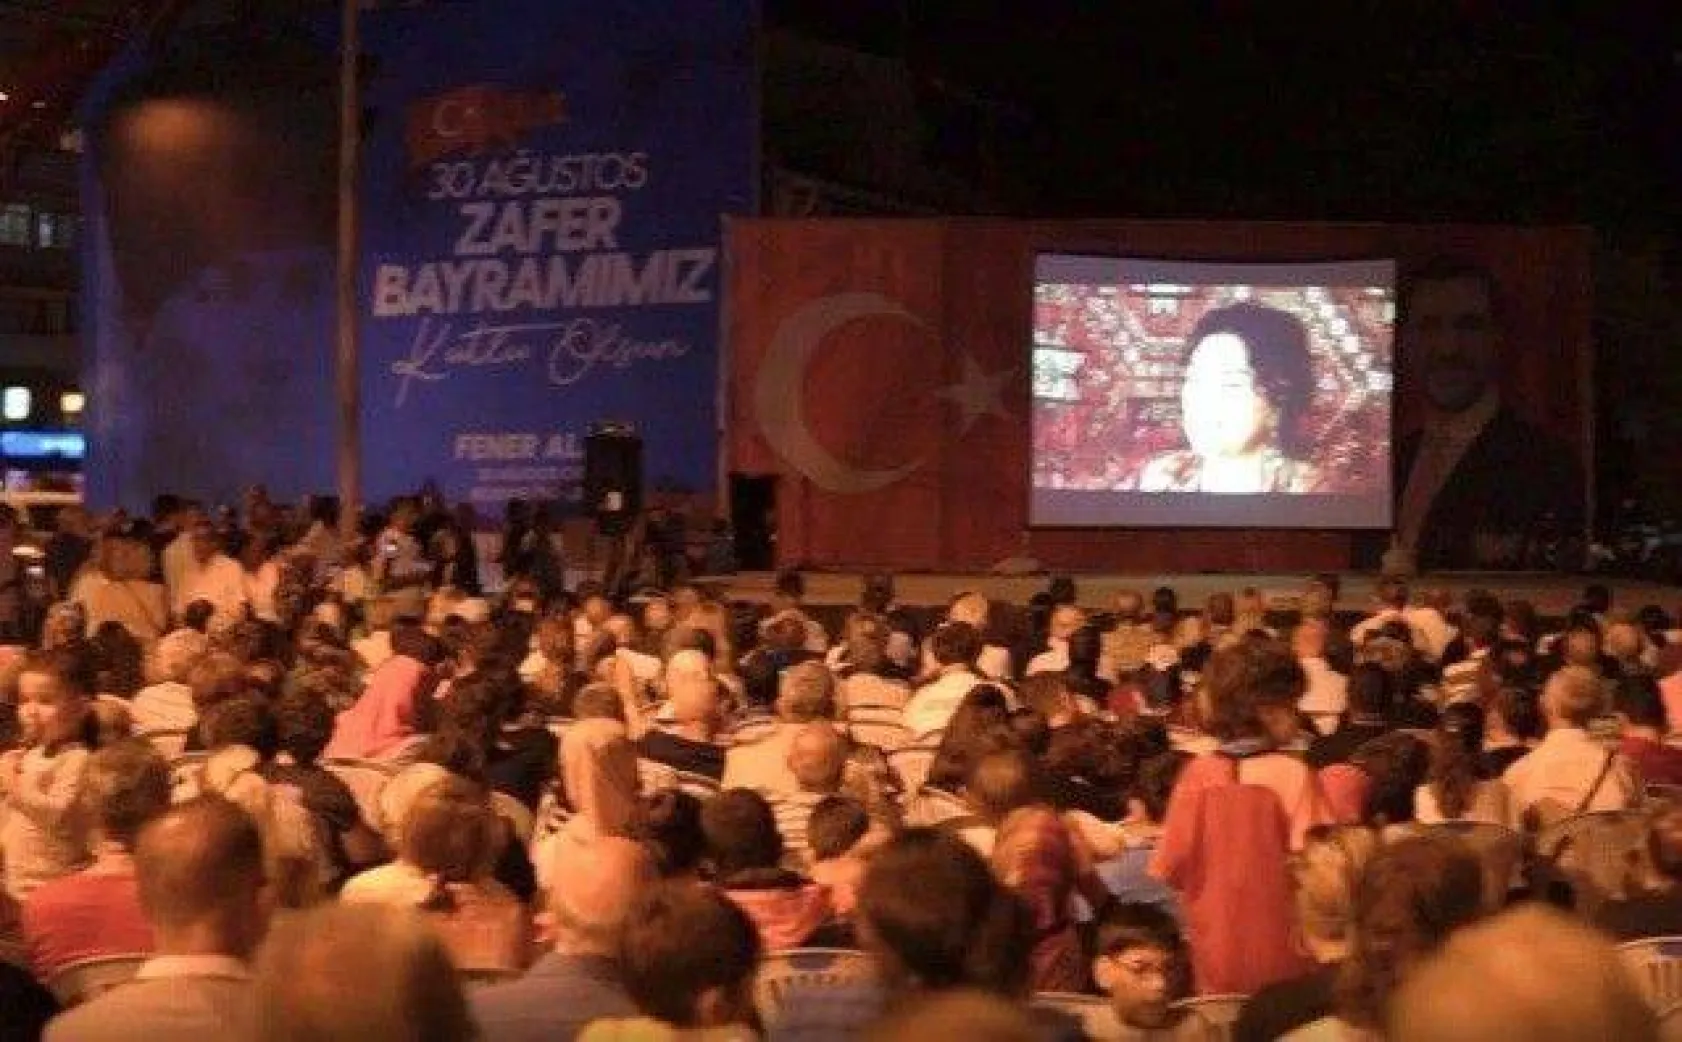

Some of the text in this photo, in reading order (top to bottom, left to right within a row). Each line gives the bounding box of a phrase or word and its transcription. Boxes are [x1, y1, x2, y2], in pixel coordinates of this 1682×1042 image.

[428, 149, 649, 200] 30 AĞUSTOS
[454, 197, 622, 256] ZAFER
[373, 249, 717, 317] BAYRAMIMIZ
[455, 432, 540, 460] FENER
